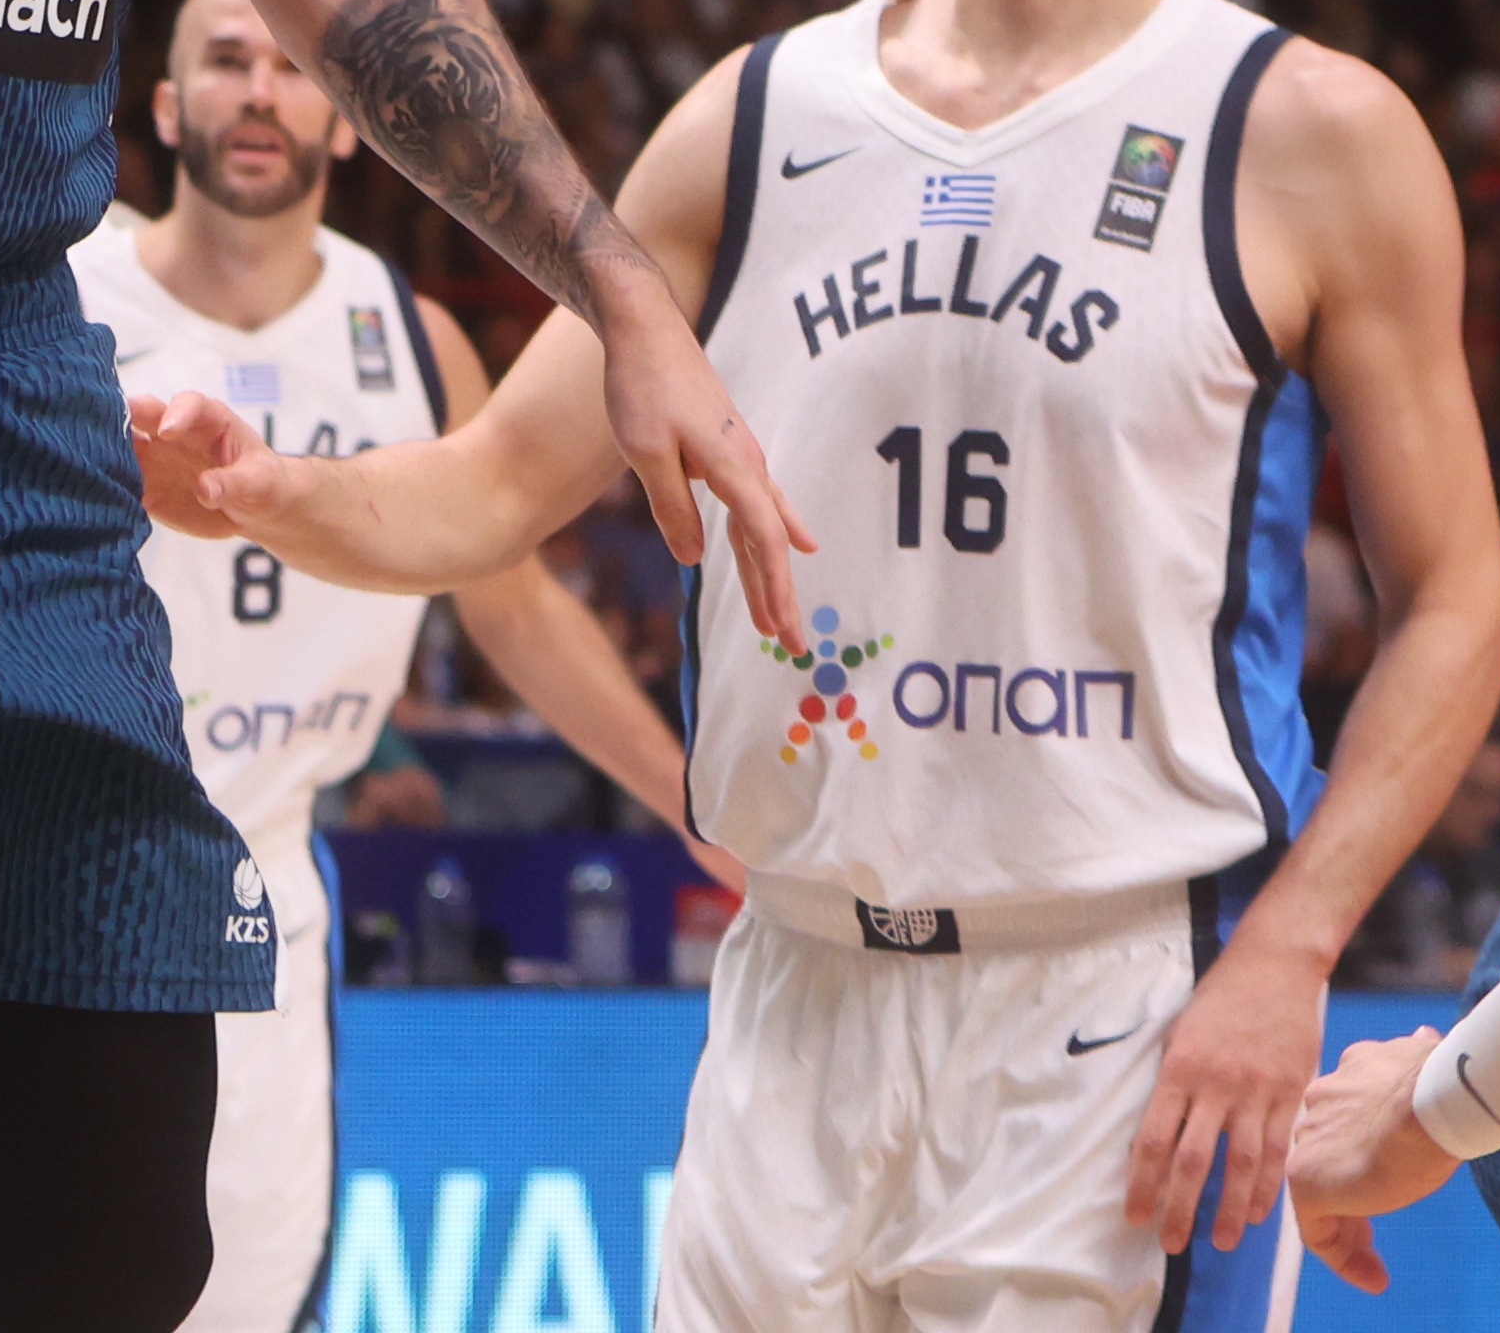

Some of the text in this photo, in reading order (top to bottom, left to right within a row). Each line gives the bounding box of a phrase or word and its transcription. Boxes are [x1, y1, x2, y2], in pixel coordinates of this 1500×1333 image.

[793, 234, 1121, 364] HELLAS
[875, 426, 1011, 554] 16
[232, 546, 282, 623] 8
[225, 915, 270, 944] KZS
